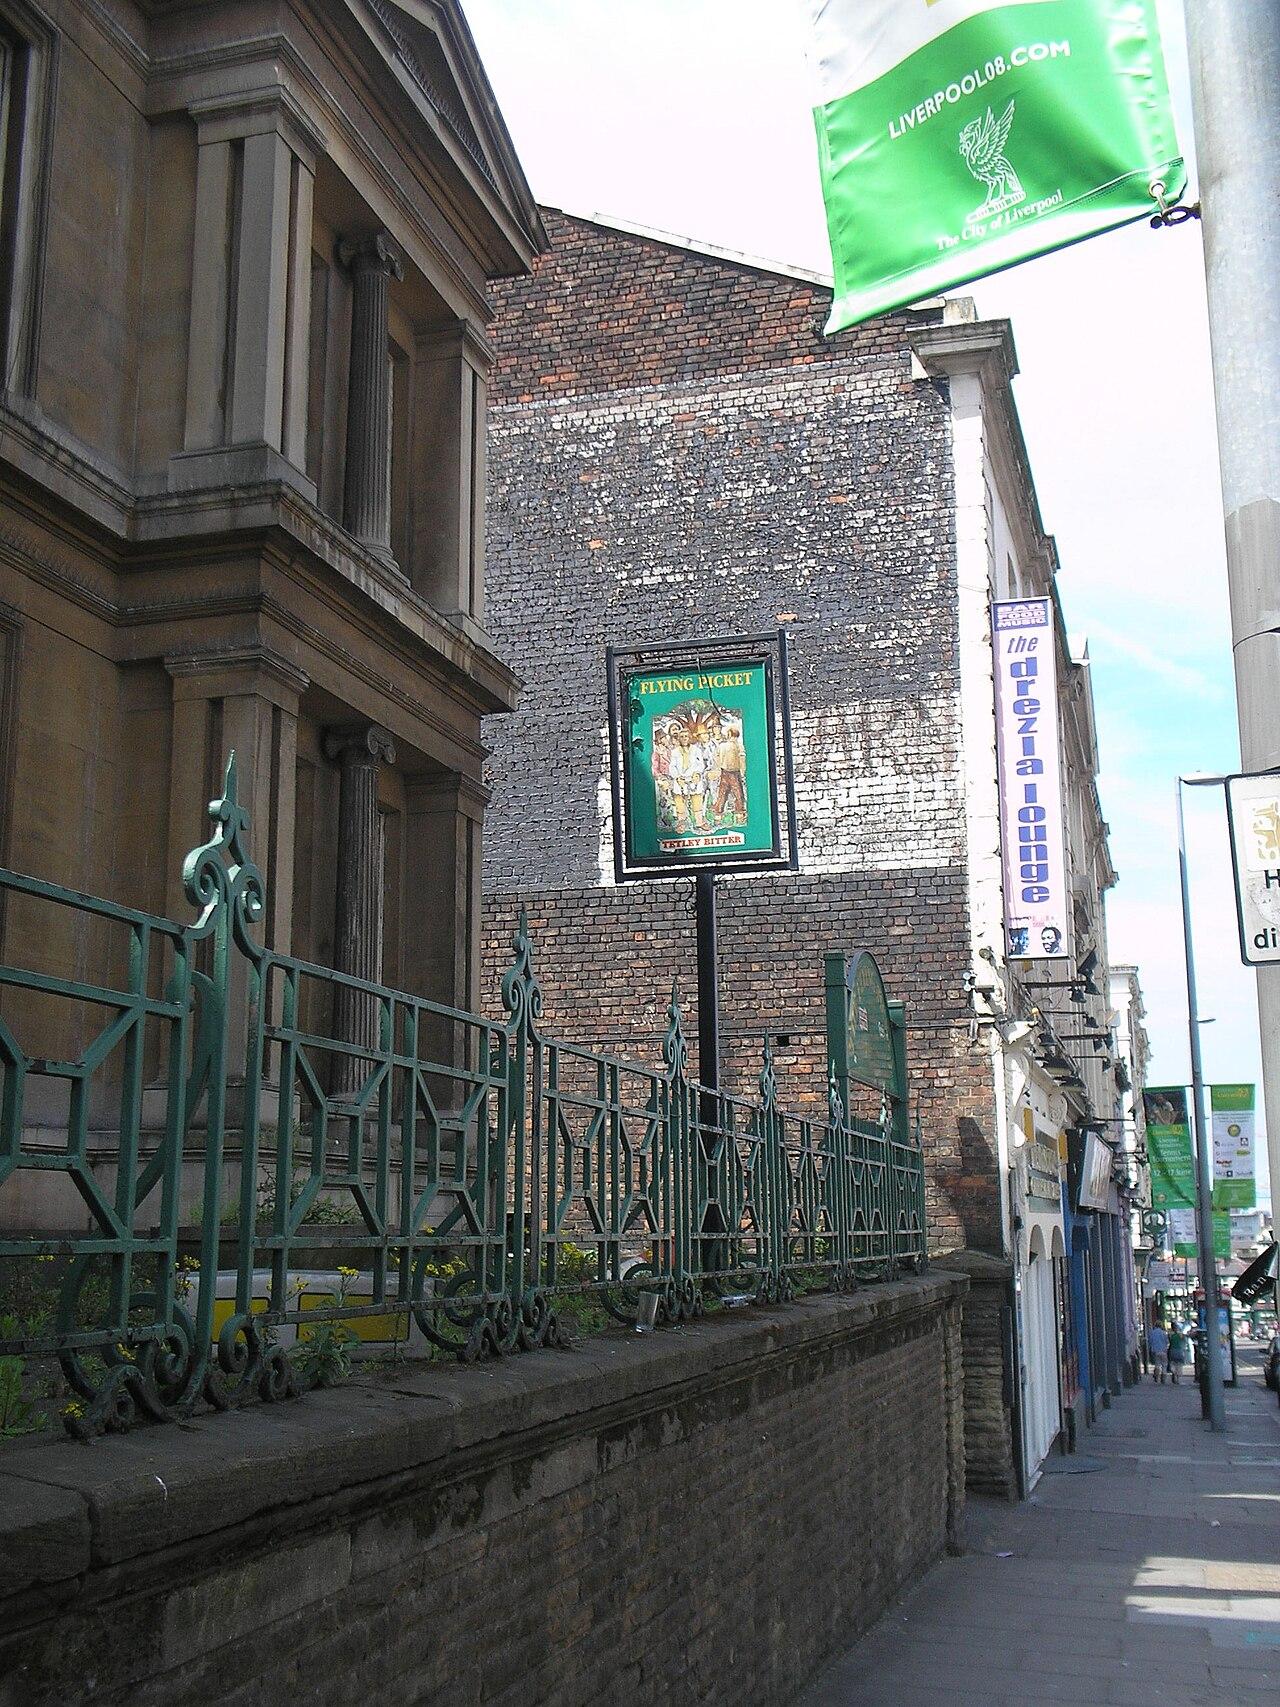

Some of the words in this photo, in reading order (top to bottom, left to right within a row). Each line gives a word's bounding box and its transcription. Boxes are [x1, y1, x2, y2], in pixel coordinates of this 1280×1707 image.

[888, 40, 1071, 139] LIVERPOOL08.COM
[937, 235, 960, 251] The
[961, 222, 987, 241] City
[991, 216, 1003, 230] of
[1004, 189, 1064, 224] Liverpool
[997, 603, 1044, 613] BAR
[997, 610, 1046, 620] FOOD
[997, 617, 1046, 627] MUSIC
[1007, 635, 1038, 654] the
[640, 678, 694, 694] FLYING
[698, 672, 753, 690] PICKET
[1010, 657, 1044, 776] drezia
[662, 839, 701, 849] TETLEY
[704, 836, 742, 846] BITTER
[1017, 783, 1050, 904] lounge
